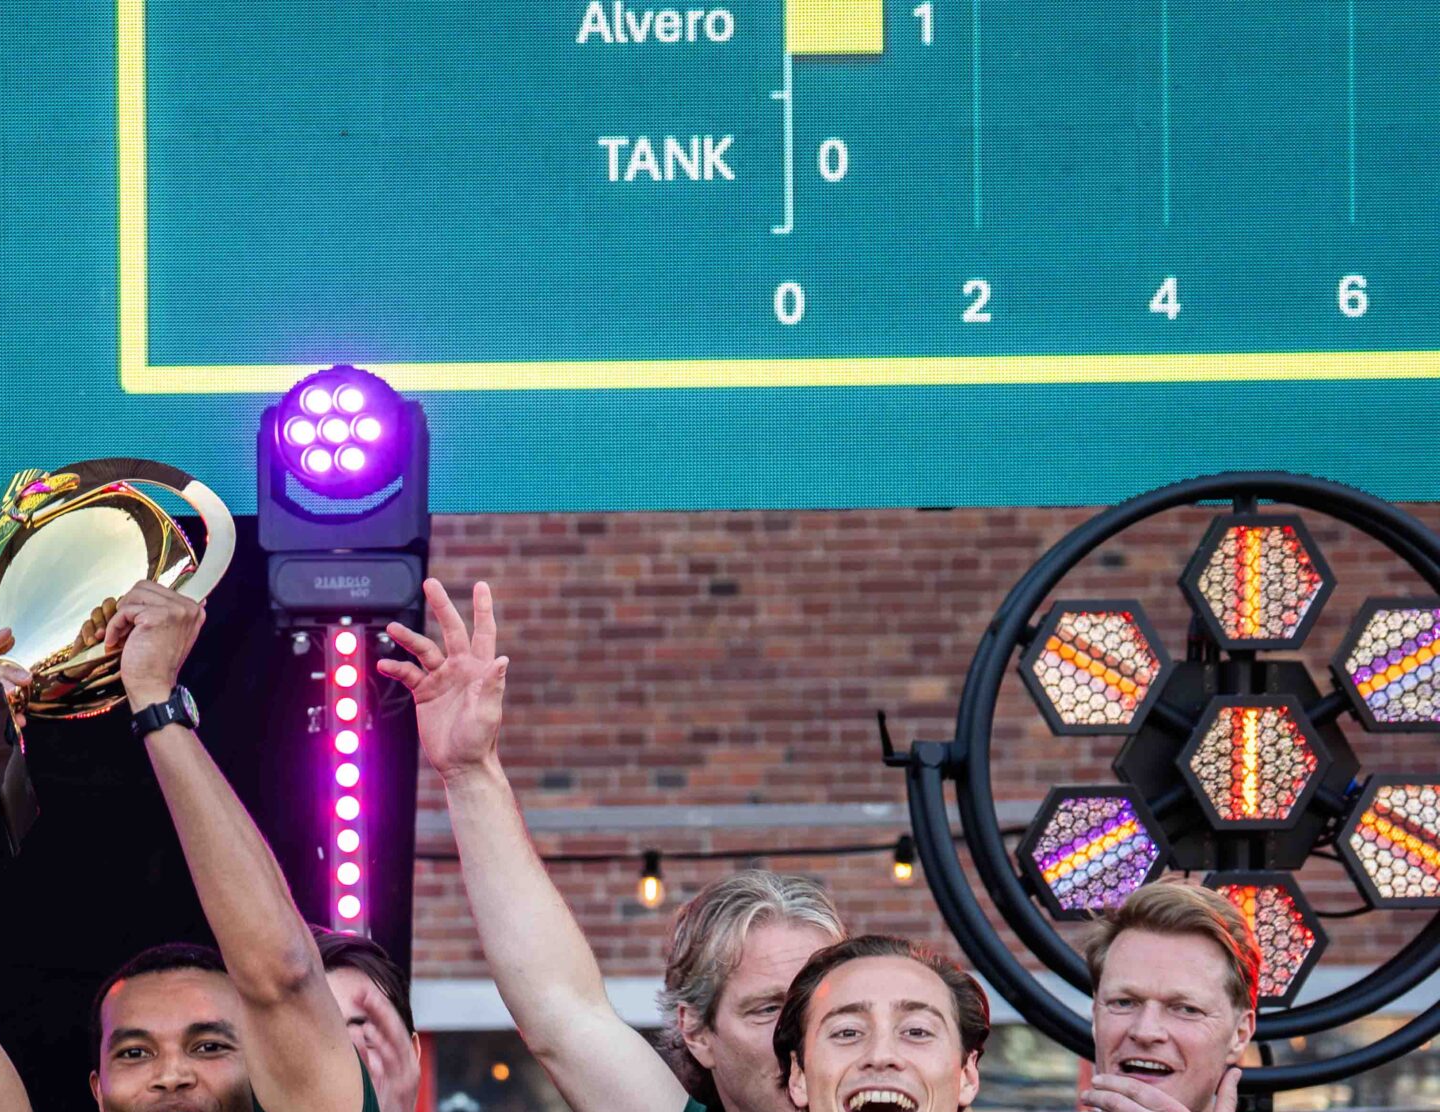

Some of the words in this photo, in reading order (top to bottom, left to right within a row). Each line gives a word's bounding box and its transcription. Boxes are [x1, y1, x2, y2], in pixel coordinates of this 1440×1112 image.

[576, 0, 735, 43] Alvero
[914, 1, 934, 45] 1
[598, 135, 736, 182] TANK
[818, 137, 849, 182] 0
[773, 282, 805, 325] 0
[962, 280, 992, 323] 2
[1148, 277, 1181, 320] 4
[1337, 275, 1368, 318] 6
